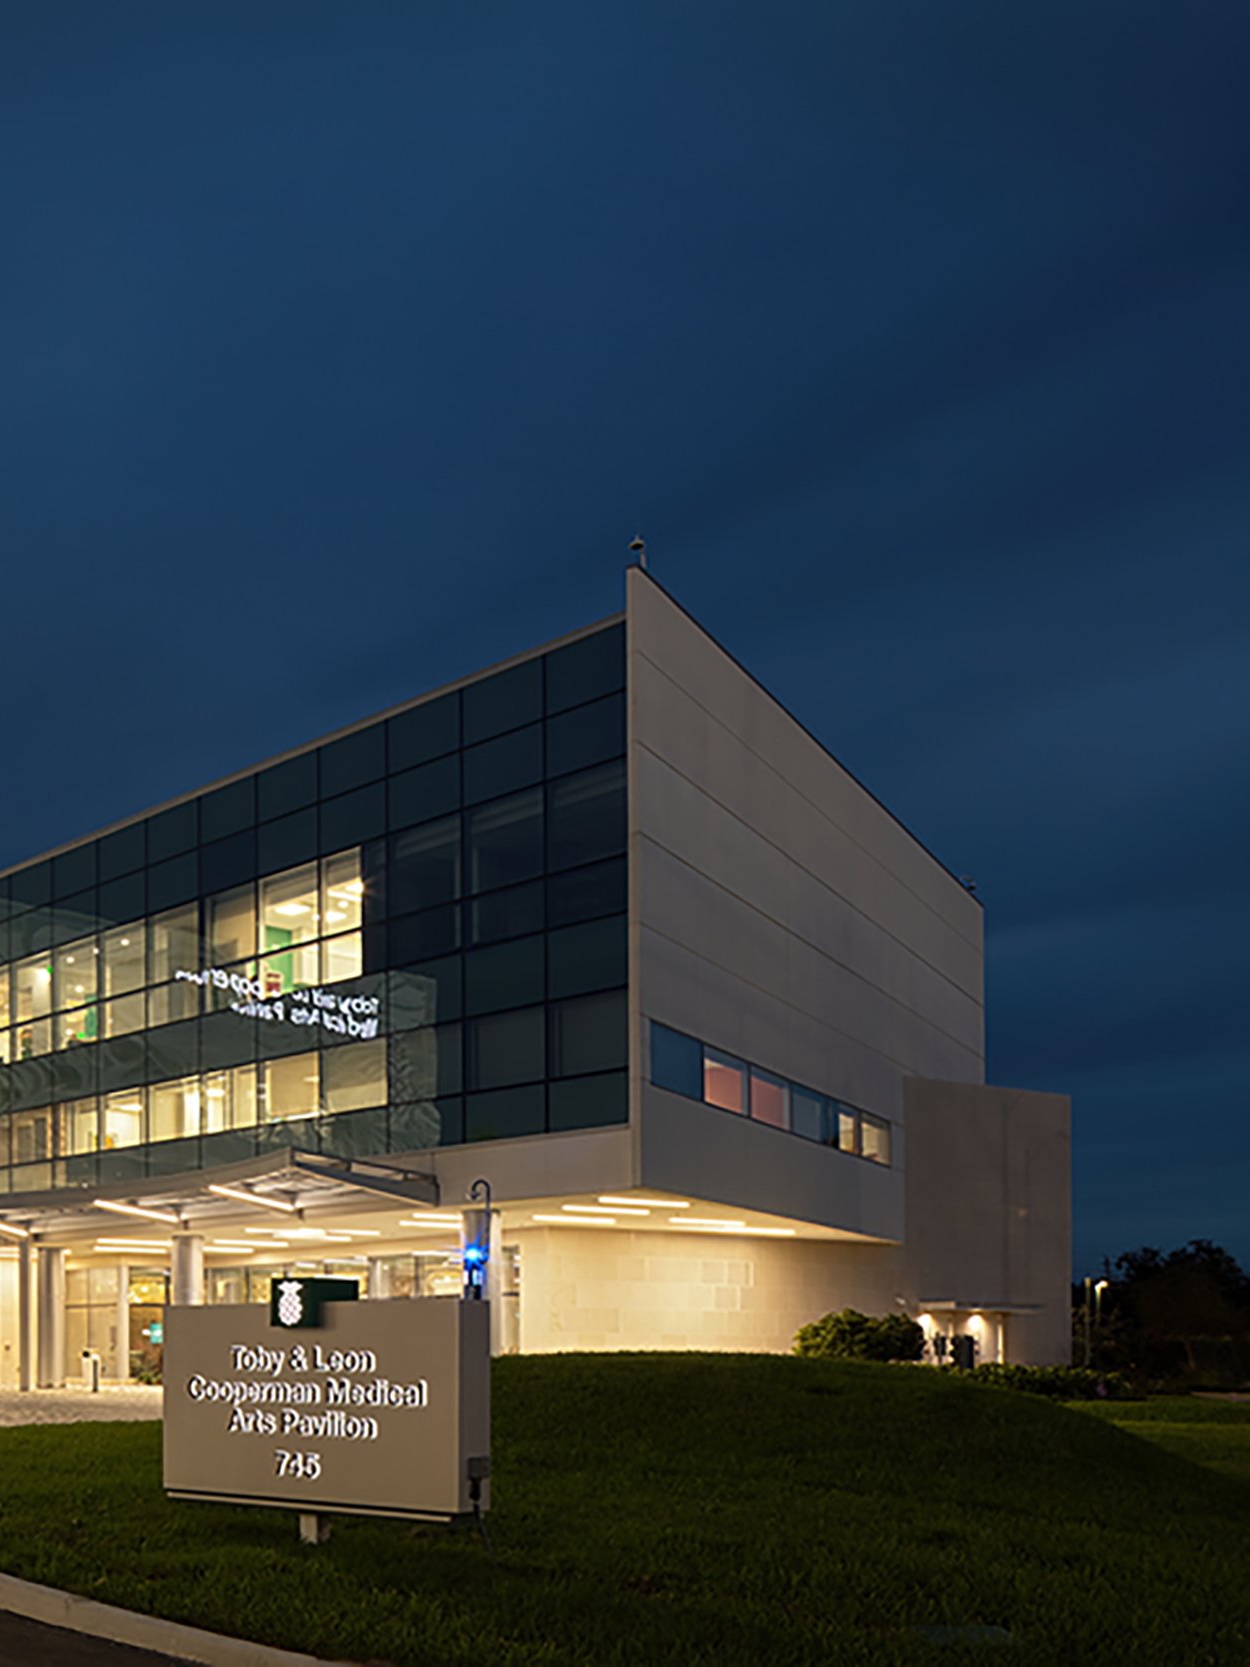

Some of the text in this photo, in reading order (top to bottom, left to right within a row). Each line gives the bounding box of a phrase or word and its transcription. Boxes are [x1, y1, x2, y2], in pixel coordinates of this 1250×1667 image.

[231, 1345, 377, 1377] Toby & Leon
[188, 1374, 429, 1408] Cooperman Medical
[228, 1408, 379, 1440] Arts Pavilion
[274, 1450, 322, 1480] 745
